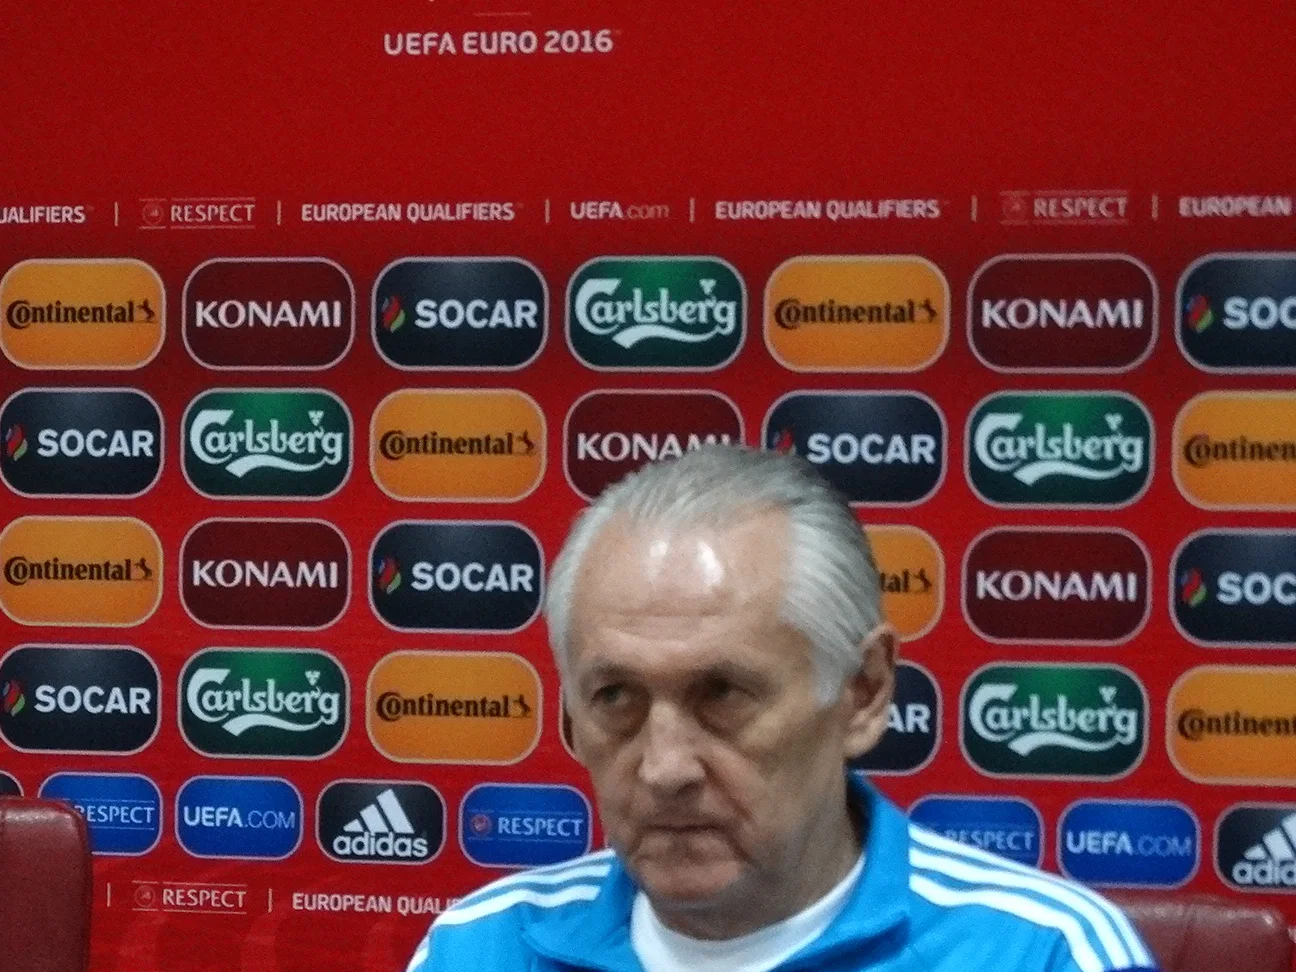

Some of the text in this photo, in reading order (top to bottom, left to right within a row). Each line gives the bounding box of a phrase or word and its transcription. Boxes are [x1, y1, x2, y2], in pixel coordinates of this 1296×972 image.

[383, 29, 614, 56] UEFA EURO 2016
[170, 204, 255, 223] RESPECT
[302, 202, 515, 224] EUROPEAN QUALIFIERS
[715, 199, 940, 222] EUROPEAN QUALIFIERS
[1034, 198, 1127, 218] RESPECT
[6, 299, 135, 329] Continental
[195, 300, 342, 329] KONAMI
[414, 299, 537, 329] SOCAR
[575, 278, 737, 348] Carlsberg
[774, 298, 915, 330] Continental
[981, 299, 1144, 329] KONAMI
[1223, 296, 1296, 330] SOC
[37, 428, 154, 457] SOCAR
[190, 409, 343, 478] Carlsberg
[380, 429, 513, 459] Continental
[807, 433, 935, 465] SOCAR
[975, 412, 1144, 485] Carlsberg
[4, 555, 132, 585] Continental
[193, 559, 338, 588] KONAMI
[411, 562, 533, 592] SOCAR
[976, 571, 1137, 601] KONAMI
[1216, 571, 1296, 606] SOC
[34, 684, 151, 715] SOCAR
[187, 668, 340, 736] Carlsberg
[376, 691, 510, 721] Continental
[969, 683, 1137, 756] Carlsberg
[497, 815, 584, 839] RESPECT
[333, 832, 428, 858] adidas
[162, 889, 247, 908] RESPECT
[292, 893, 392, 913] EUROPEAN
